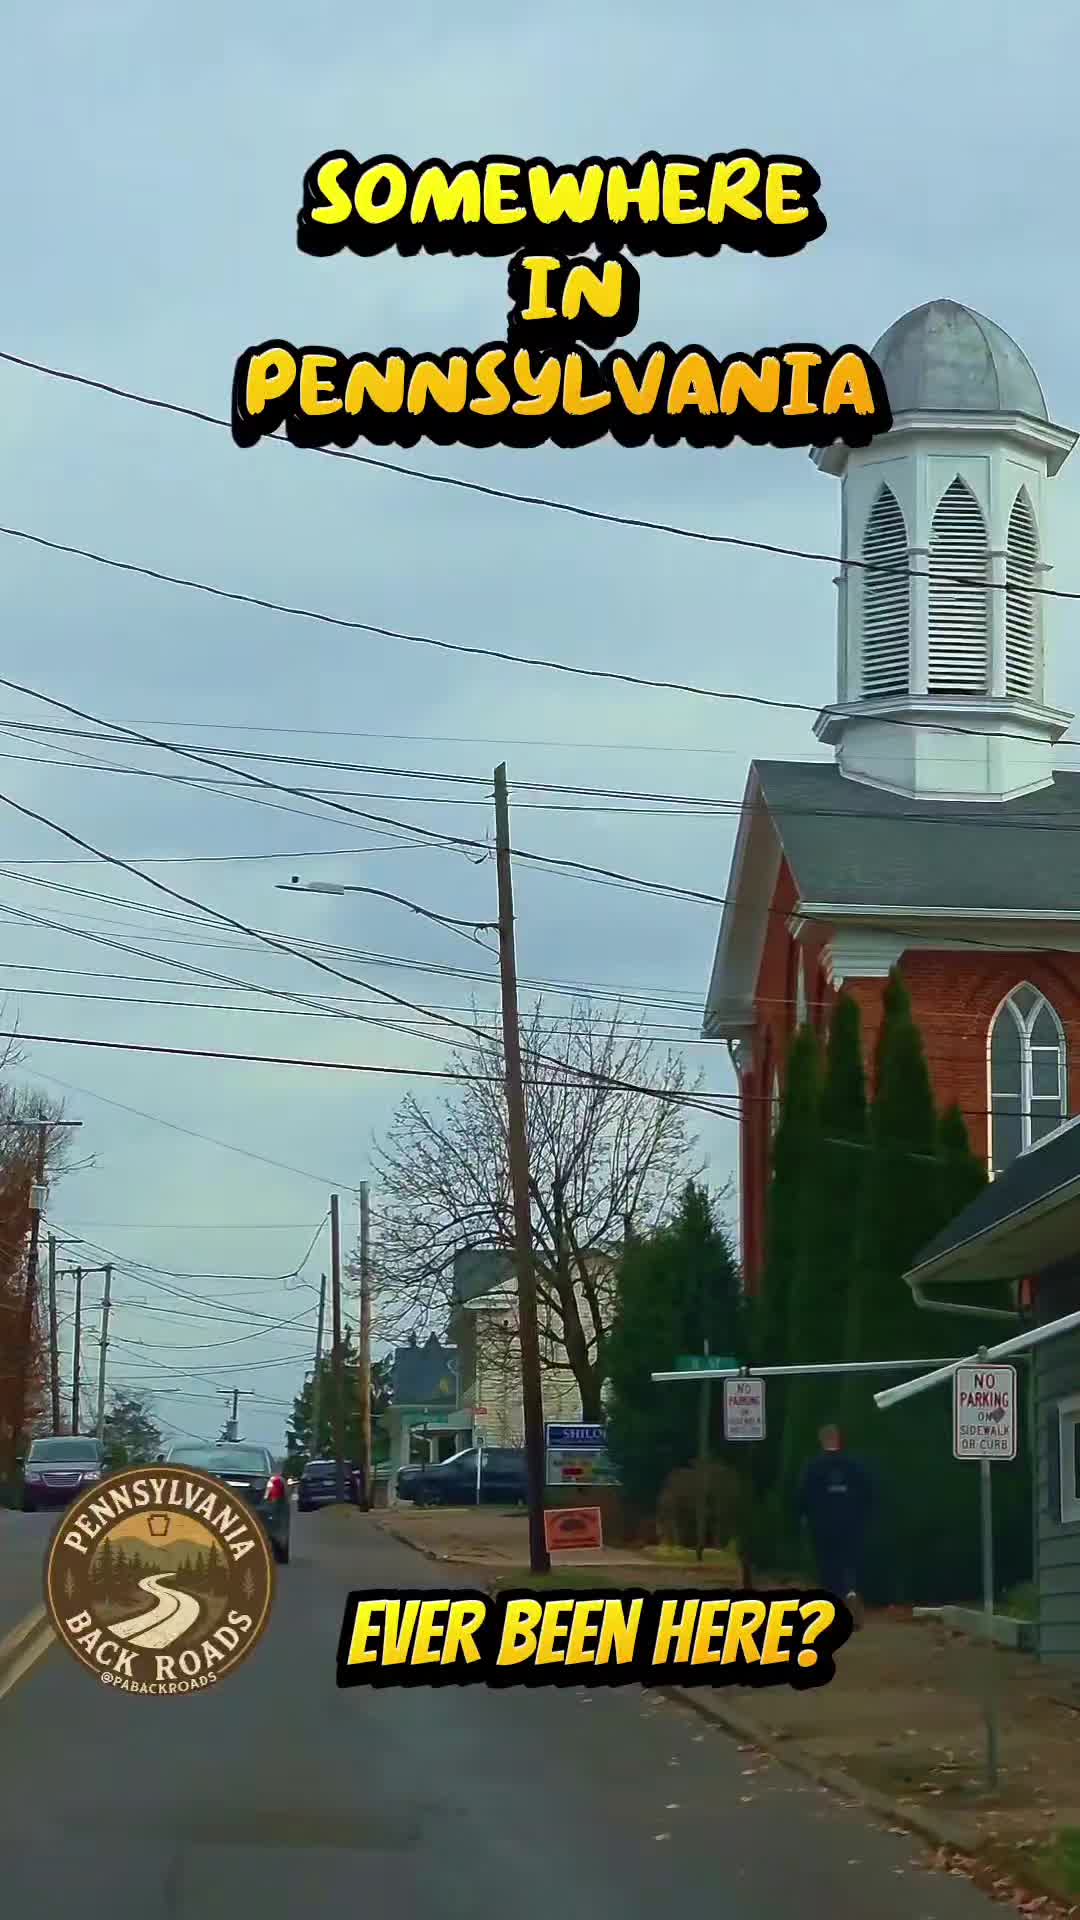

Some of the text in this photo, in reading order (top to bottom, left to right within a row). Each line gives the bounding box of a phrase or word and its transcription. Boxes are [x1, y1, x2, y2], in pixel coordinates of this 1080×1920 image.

[974, 1374, 995, 1389] NO
[736, 1383, 752, 1394] NO
[960, 1392, 1009, 1408] PARKING
[980, 1438, 1008, 1450] CURB
